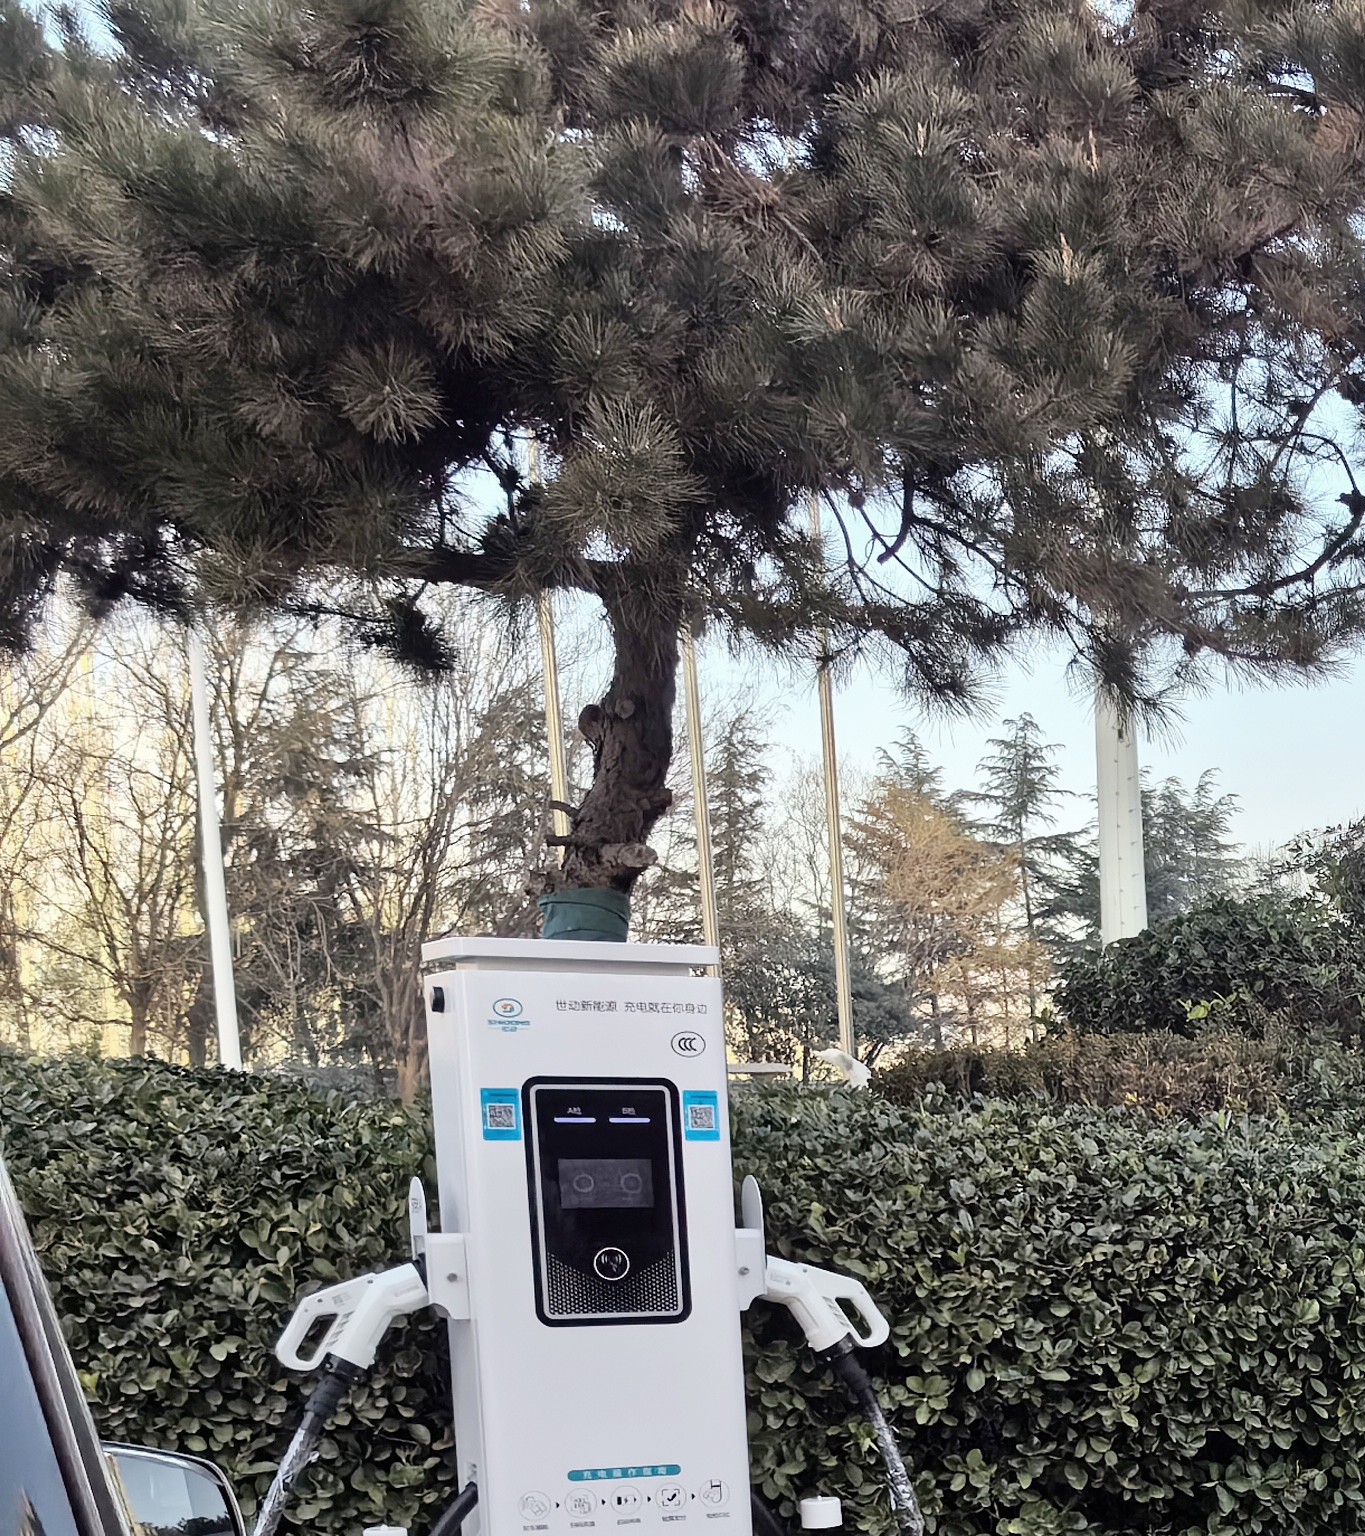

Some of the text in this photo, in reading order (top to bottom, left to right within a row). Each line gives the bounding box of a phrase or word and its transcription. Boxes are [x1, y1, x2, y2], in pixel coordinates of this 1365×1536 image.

[555, 999, 708, 1015] 世动新能源 充电就在你身边
